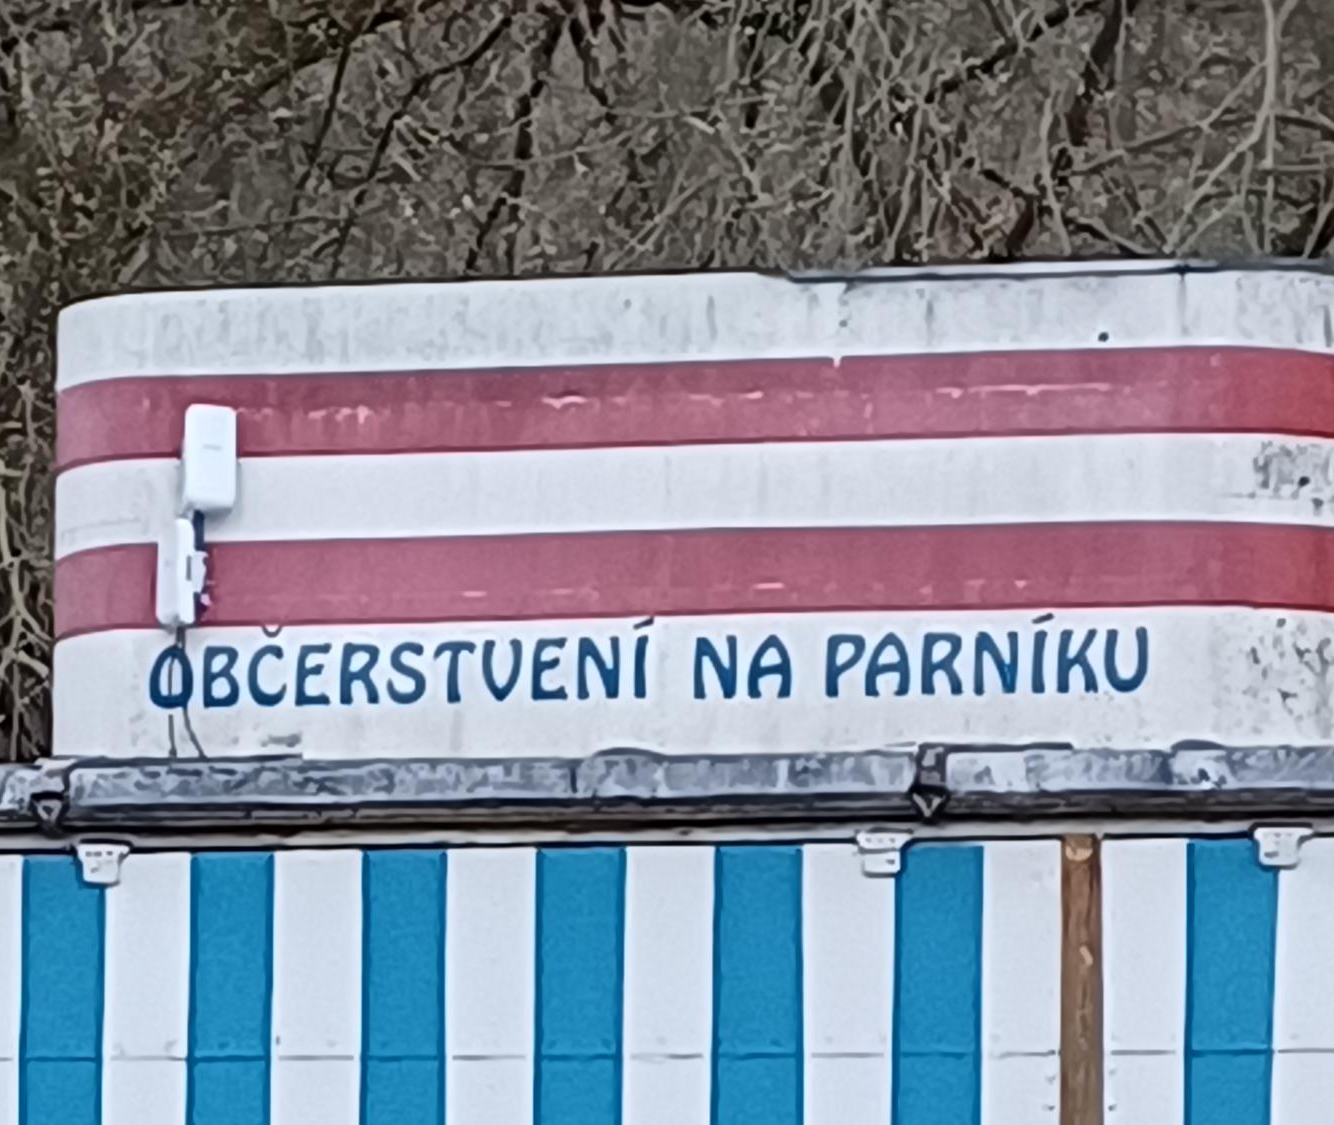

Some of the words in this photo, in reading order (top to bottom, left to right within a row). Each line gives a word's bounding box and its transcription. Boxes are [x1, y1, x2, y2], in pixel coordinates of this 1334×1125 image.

[149, 616, 654, 709] OBČERSTVENÍ
[693, 633, 792, 700] NA
[825, 612, 1149, 698] PARNÍKU
